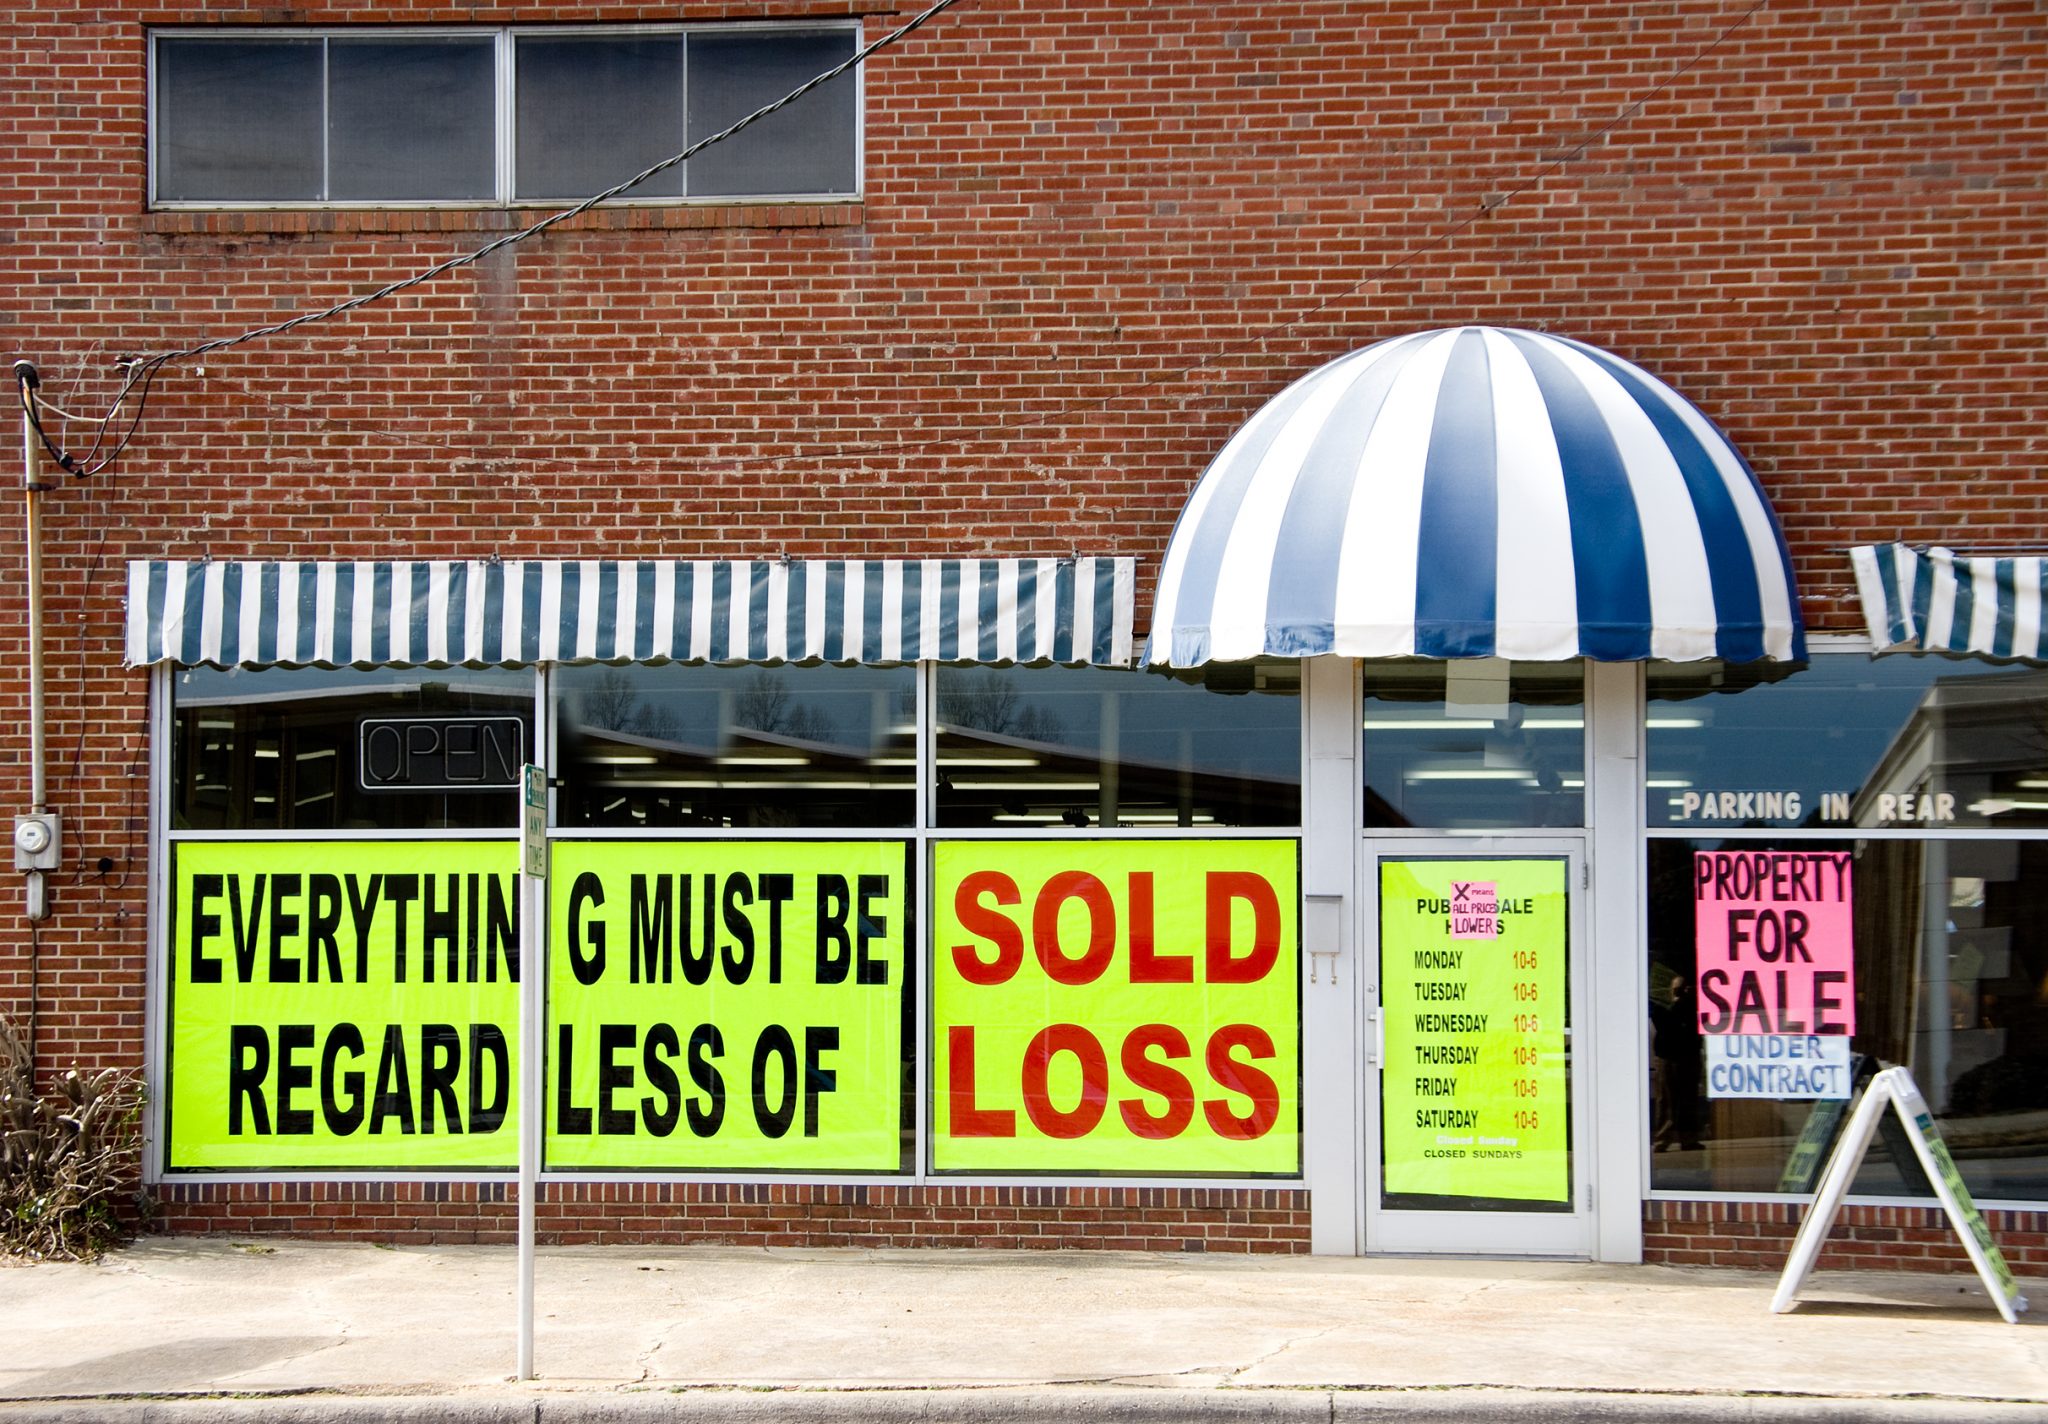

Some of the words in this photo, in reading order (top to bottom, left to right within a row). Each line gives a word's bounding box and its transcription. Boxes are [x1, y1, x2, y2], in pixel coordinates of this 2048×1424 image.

[366, 723, 517, 782] OPEN
[1683, 792, 1801, 820] PARKING
[1821, 793, 1850, 820] IN
[1878, 793, 1955, 820] REAR
[1696, 853, 1851, 902] PROPERTY
[1453, 903, 1469, 914] ALL
[629, 872, 794, 986] MUST
[815, 873, 890, 986] BE
[951, 870, 1281, 986] SOLD
[1455, 917, 1494, 934] LOWER
[1728, 909, 1813, 963] FOR
[1414, 950, 1463, 970] MONDAY
[1513, 950, 1537, 970] 10-6
[1414, 982, 1467, 1001] TUESDAY
[1513, 982, 1538, 1002] 10-6
[1700, 970, 1847, 1035] SALE
[1415, 1014, 1488, 1033] WEDNESDAY
[1513, 1014, 1538, 1033] 10-6
[1415, 1046, 1479, 1065] THURSDAY
[1513, 1046, 1538, 1066] 10-6
[1725, 1036, 1822, 1059] UNDER
[751, 1023, 840, 1140] OF
[949, 1023, 1280, 1141] LOSS
[1415, 1078, 1457, 1097] FRIDAY
[1513, 1079, 1538, 1098] 10-6
[1711, 1064, 1841, 1094] CONTRACT
[1416, 1110, 1479, 1129] SATURDAY
[1513, 1111, 1538, 1130] 10-6
[1423, 1149, 1466, 1159] CLOSED
[1472, 1150, 1523, 1159] SUNDAYS
